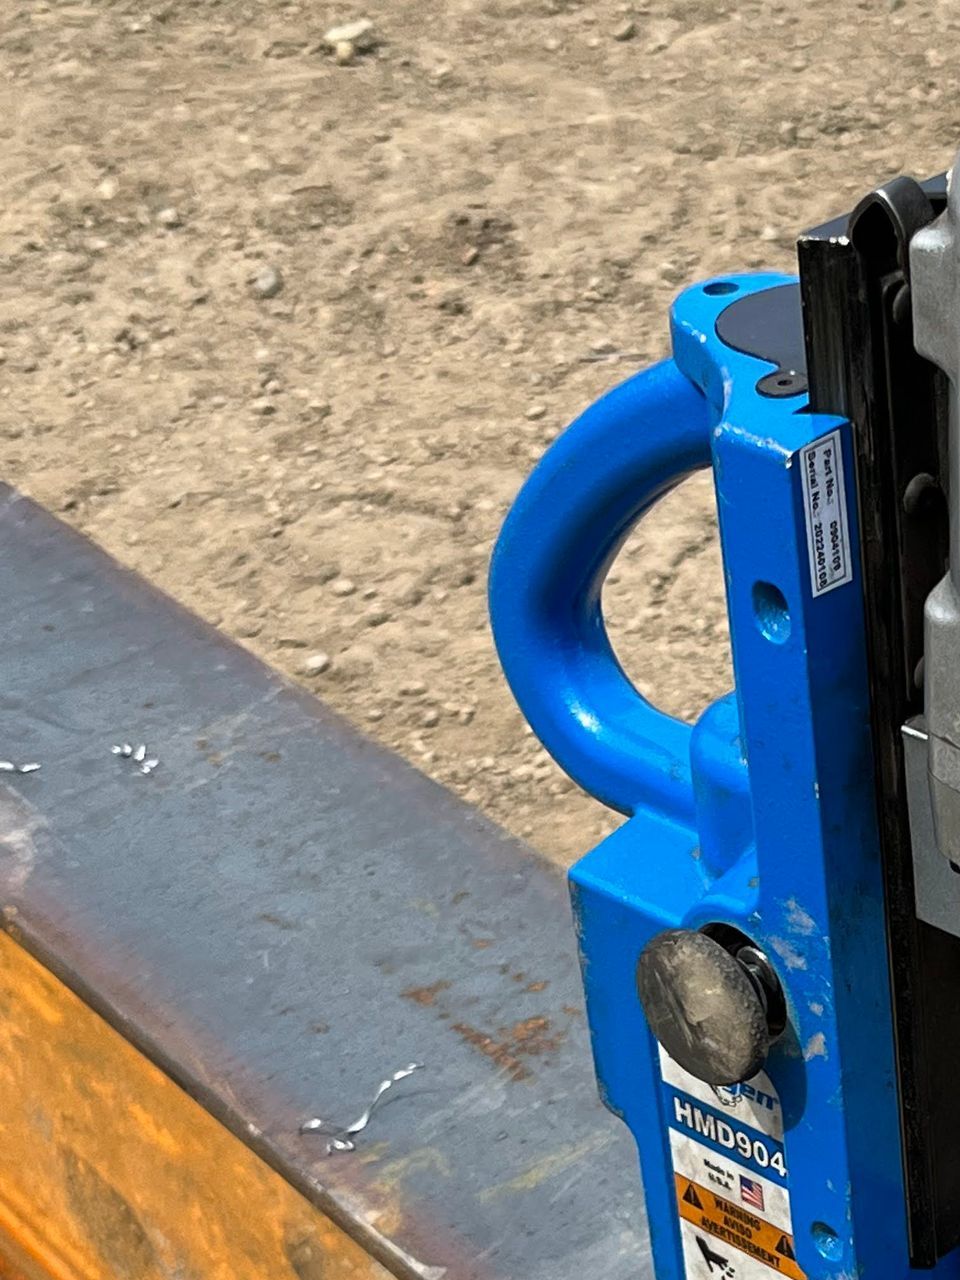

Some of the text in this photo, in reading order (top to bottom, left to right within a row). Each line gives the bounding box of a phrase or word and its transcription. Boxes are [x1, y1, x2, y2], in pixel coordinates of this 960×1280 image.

[807, 451, 820, 489] Serial
[823, 449, 833, 476] Part
[673, 1096, 787, 1177] HMD904
[714, 1196, 761, 1231] WARNING
[701, 1215, 780, 1267] AVERTISSEMENT
